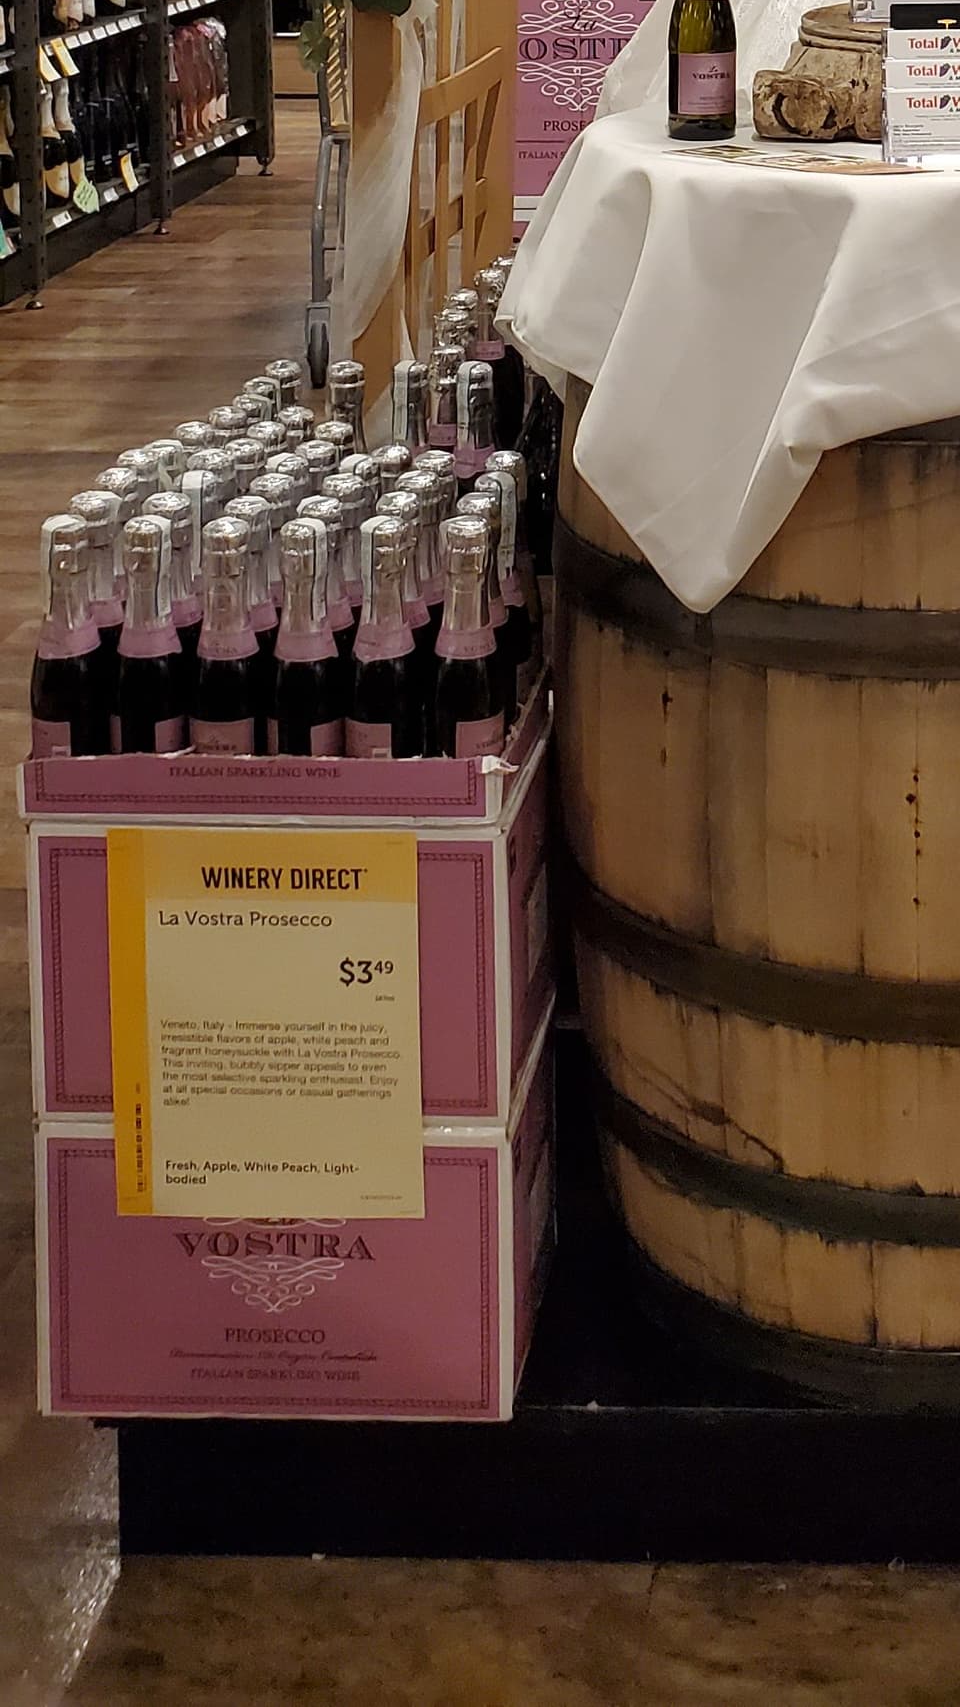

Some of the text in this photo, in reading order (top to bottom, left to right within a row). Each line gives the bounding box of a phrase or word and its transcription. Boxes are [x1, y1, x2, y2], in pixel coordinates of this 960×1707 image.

[908, 37, 938, 49] Total
[906, 65, 937, 76] Total
[906, 96, 938, 109] Total
[543, 121, 587, 132] PROSE
[518, 151, 557, 159] ITALIAN
[169, 767, 341, 778] ITALIAN SPARKLING WINE
[201, 867, 363, 890] WINERY DIRECT
[159, 911, 332, 927] La Vostra Prosecco
[166, 1161, 359, 1175] Fresh, Apple, White Peach, Light-
[166, 1175, 206, 1184] bodied
[174, 1231, 376, 1261] VOSTRA
[225, 1327, 326, 1344] PROSECCO
